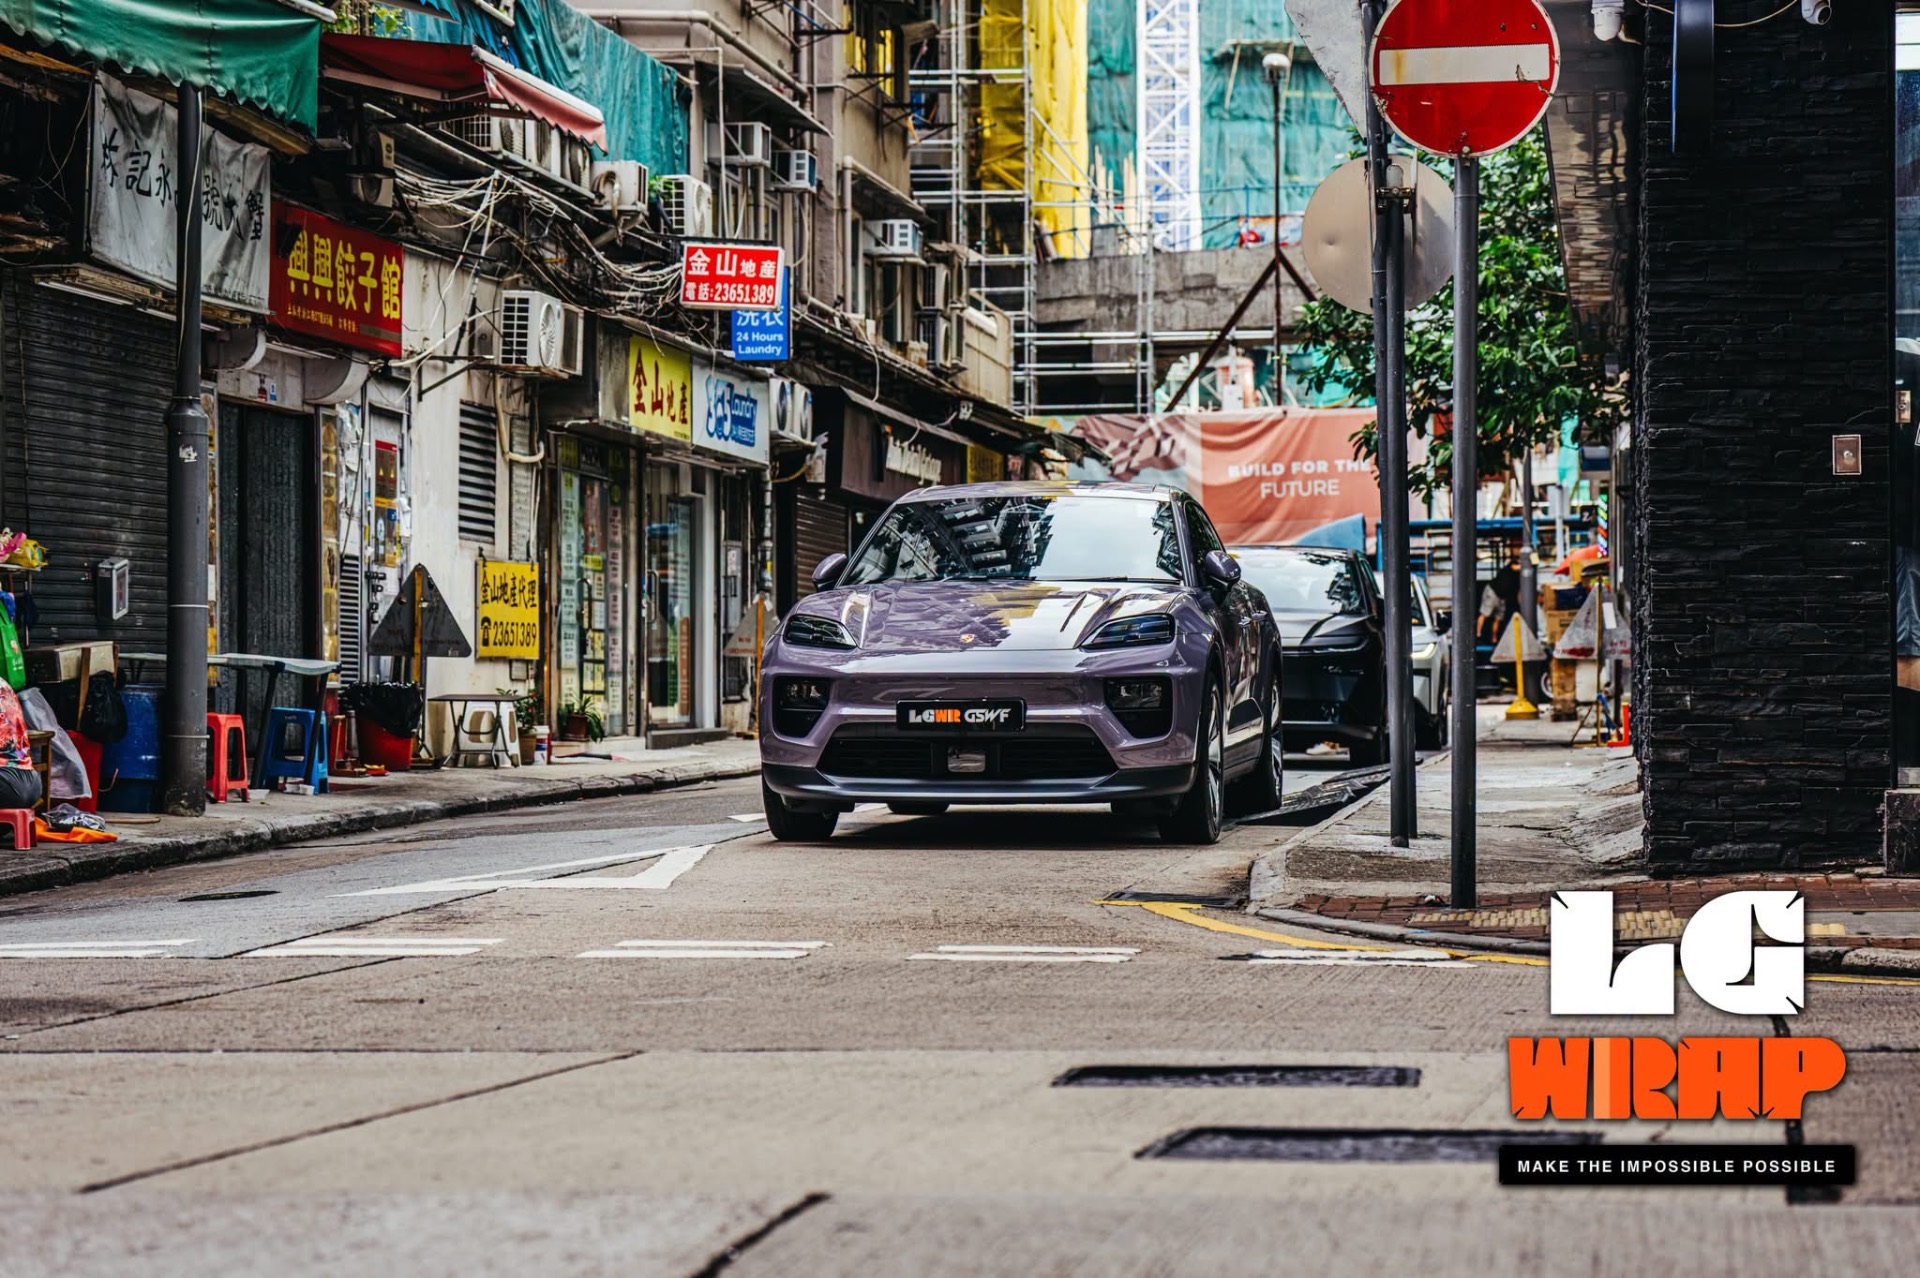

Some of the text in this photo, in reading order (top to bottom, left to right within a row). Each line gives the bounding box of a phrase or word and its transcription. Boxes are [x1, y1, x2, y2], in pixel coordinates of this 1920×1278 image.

[687, 248, 777, 279] 金山地產
[736, 332, 784, 342] 24 Hours
[738, 345, 782, 356] Laundry
[632, 346, 688, 425] 金山地產
[1228, 458, 1371, 478] BUILD FOR THE
[1260, 478, 1340, 499] FUTURE
[480, 570, 538, 609] 金山地產代理
[492, 620, 537, 647] 23651389
[964, 708, 1012, 723] GSWF
